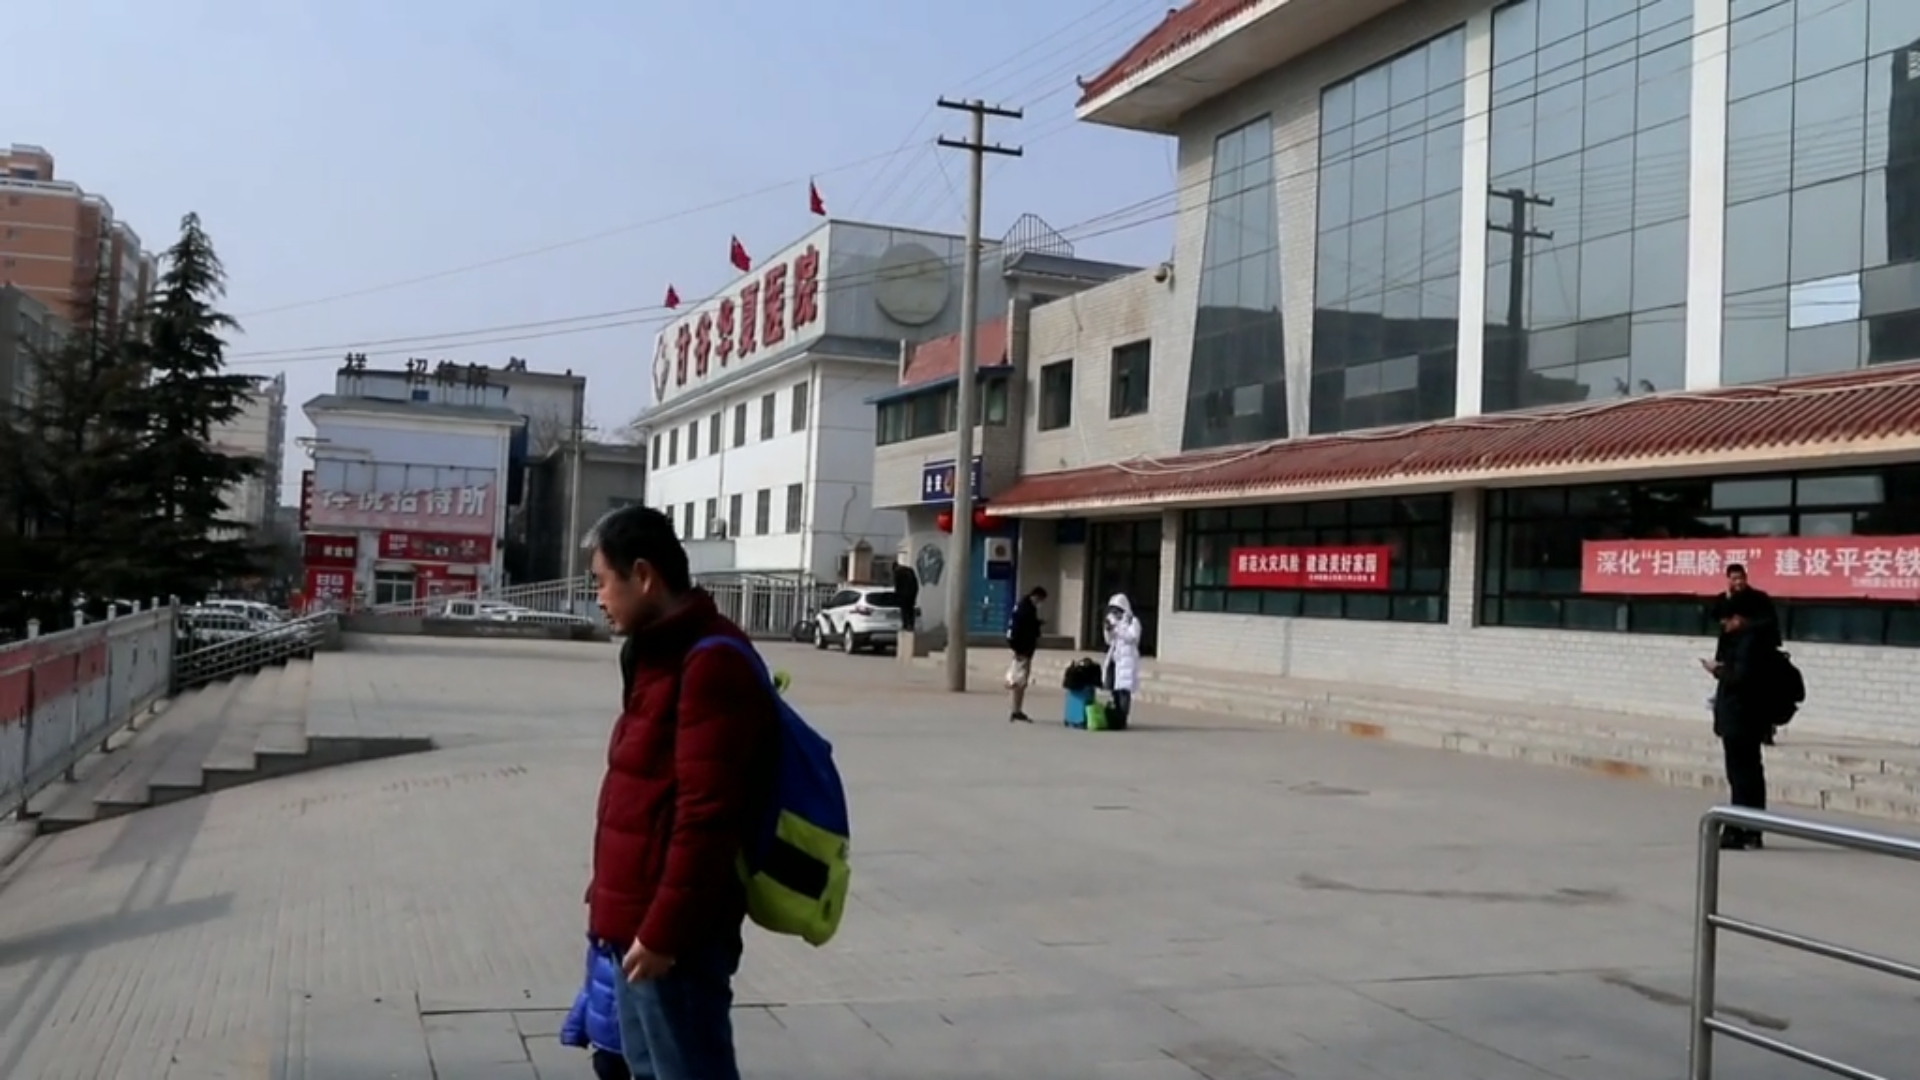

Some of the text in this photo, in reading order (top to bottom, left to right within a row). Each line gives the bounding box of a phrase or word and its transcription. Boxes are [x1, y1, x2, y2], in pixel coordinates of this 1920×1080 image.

[675, 244, 820, 387] 甘谷华夏医院
